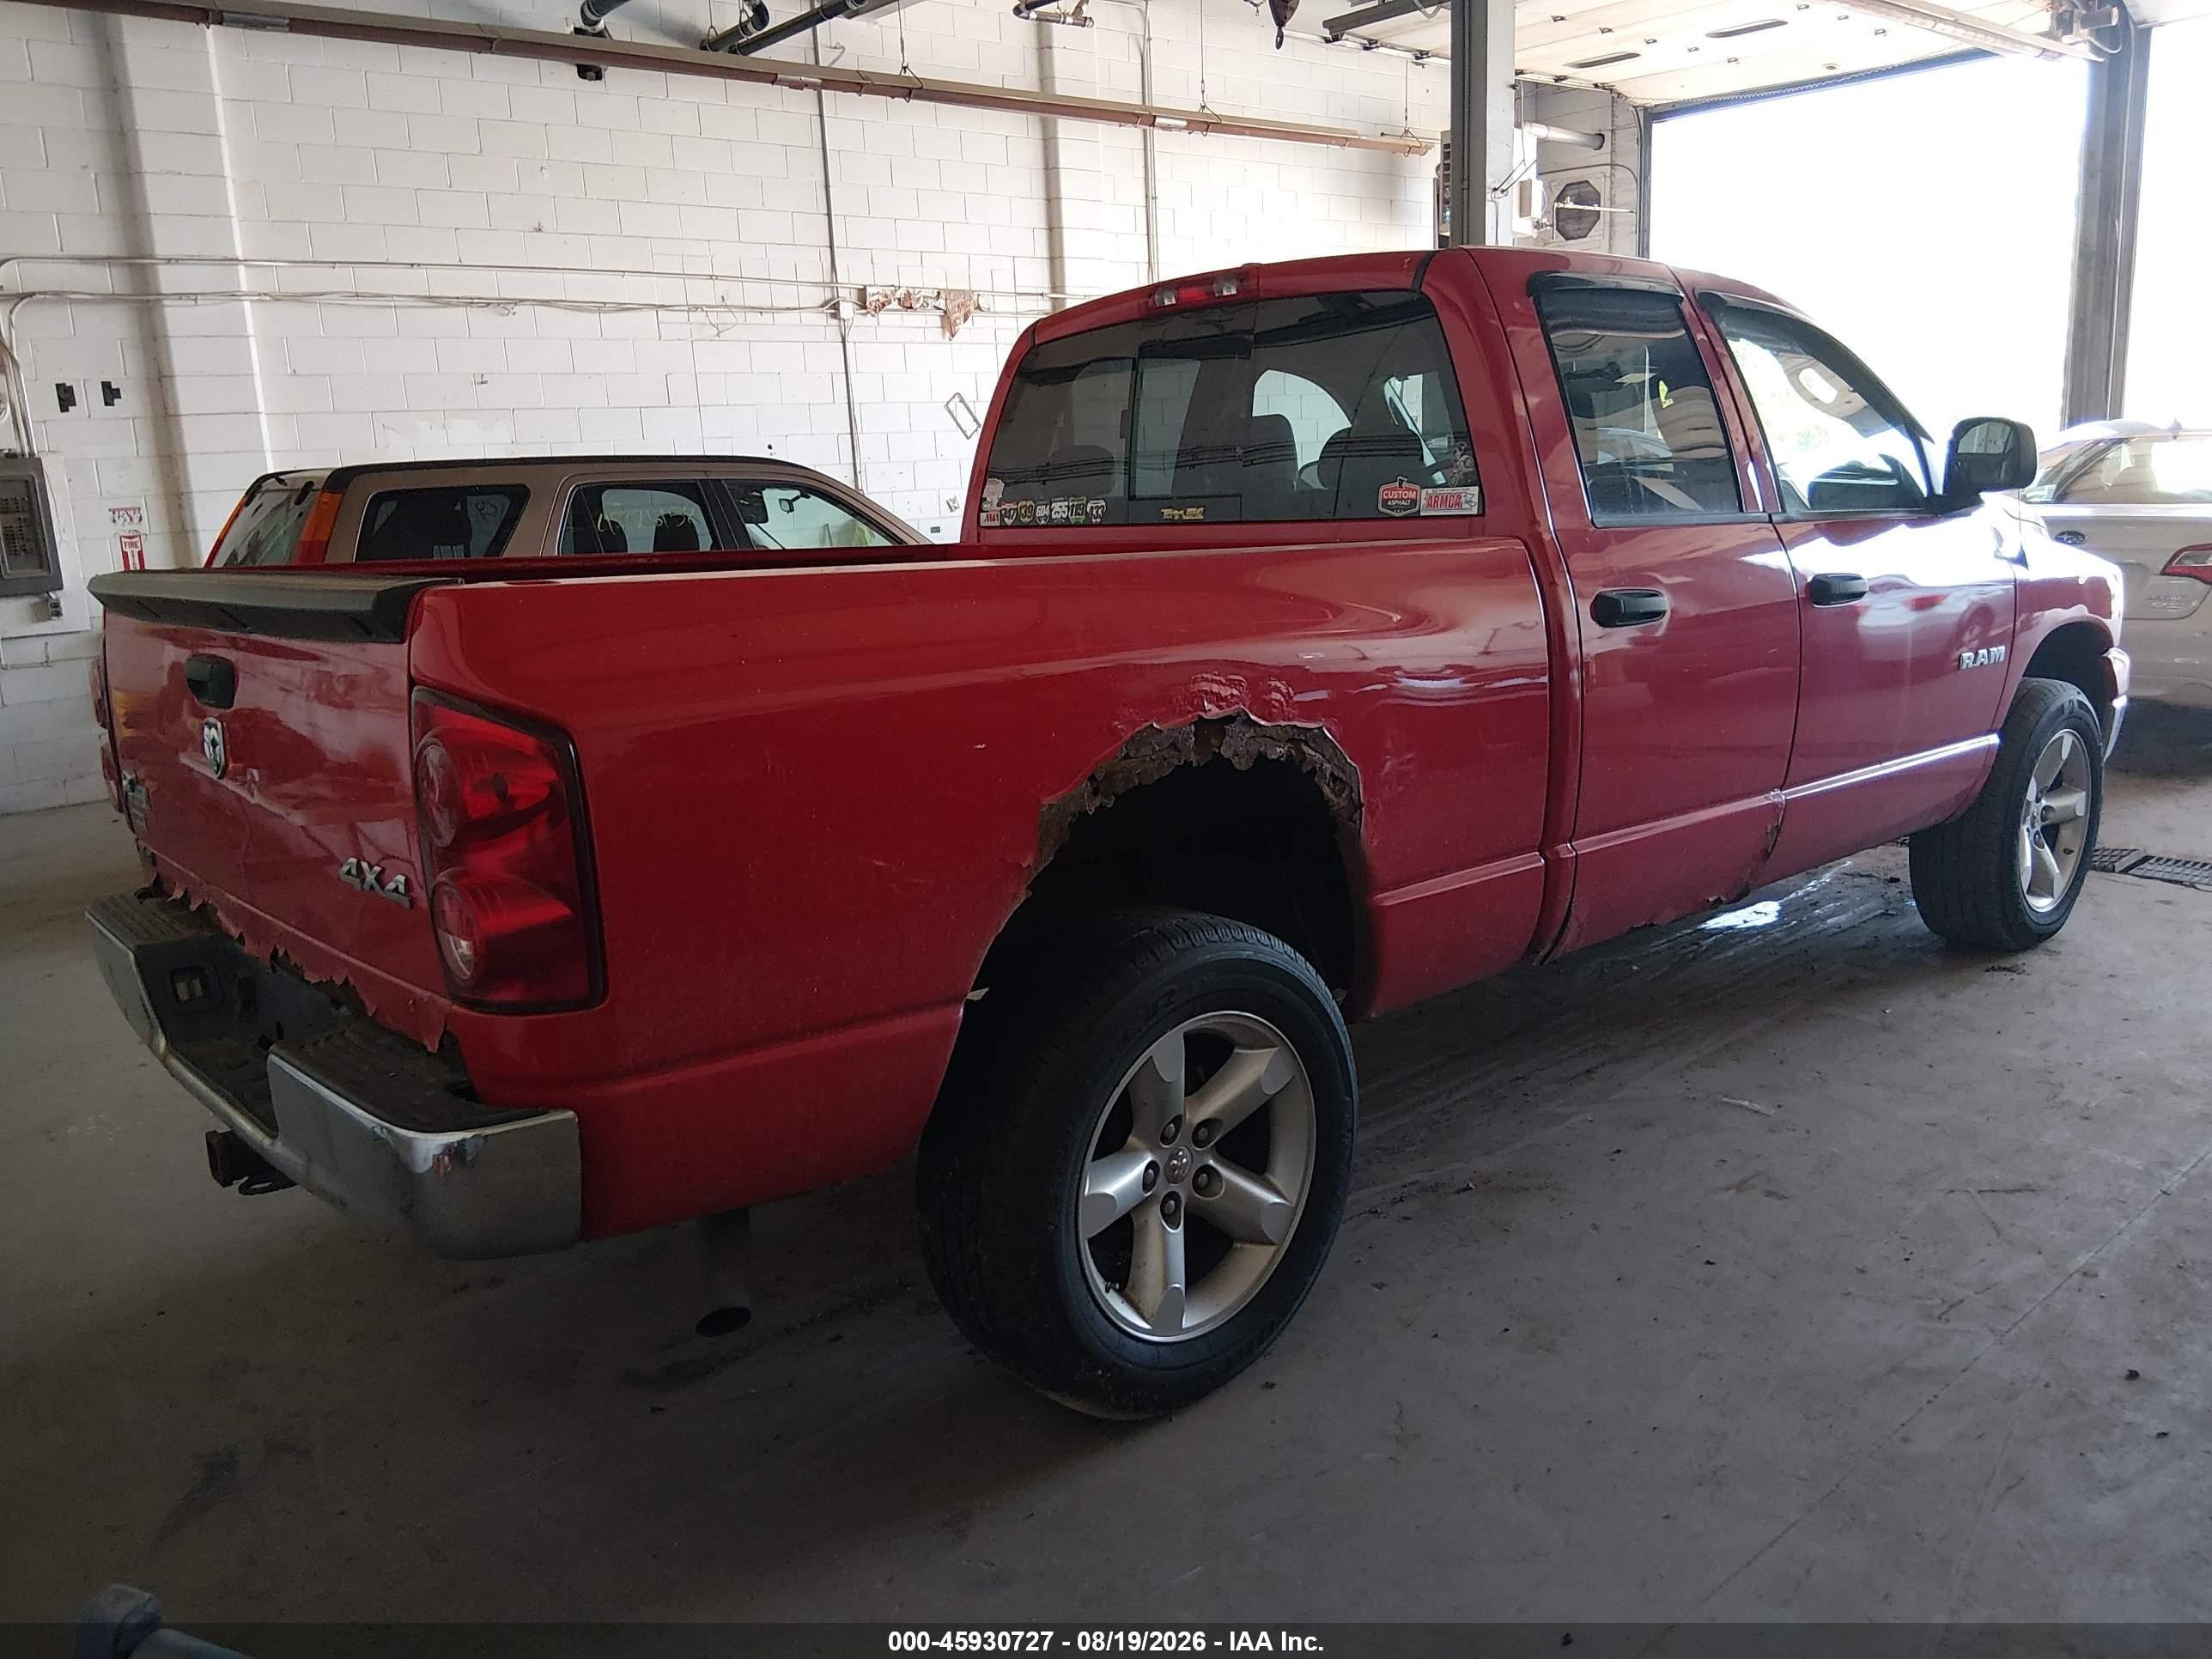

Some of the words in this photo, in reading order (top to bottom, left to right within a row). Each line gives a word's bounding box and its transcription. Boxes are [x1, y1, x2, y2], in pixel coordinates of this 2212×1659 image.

[1383, 490, 1416, 499] CUSTOM
[1426, 494, 1462, 508] ARMCA
[1051, 501, 1069, 519] 255
[1960, 646, 2006, 671] RAM
[339, 857, 411, 909] 4X4
